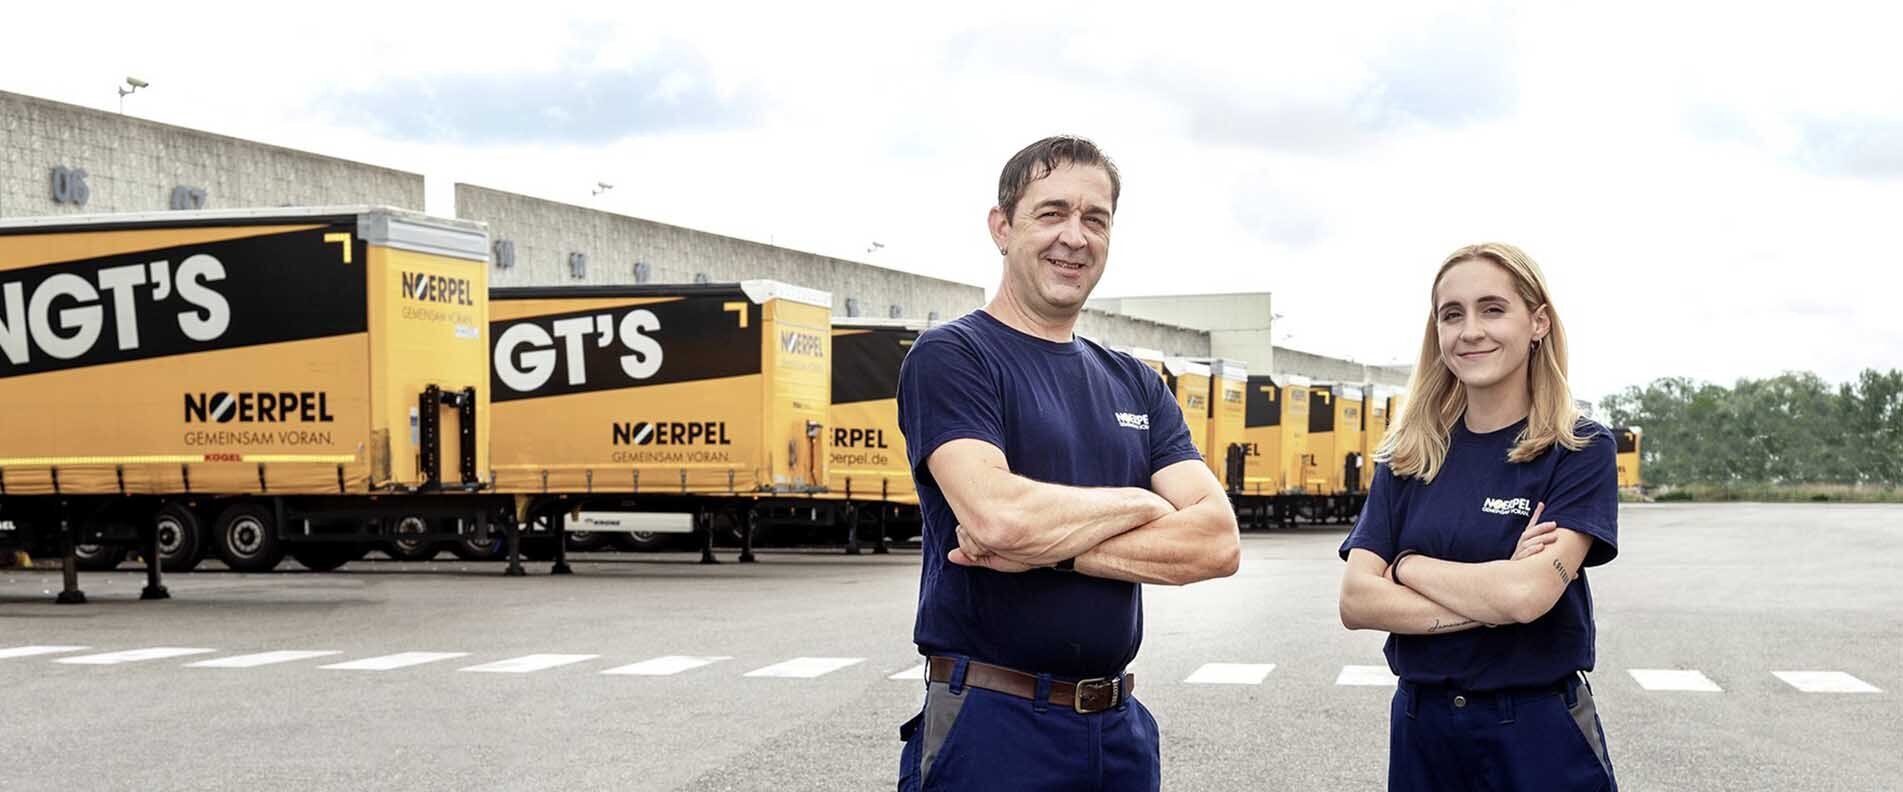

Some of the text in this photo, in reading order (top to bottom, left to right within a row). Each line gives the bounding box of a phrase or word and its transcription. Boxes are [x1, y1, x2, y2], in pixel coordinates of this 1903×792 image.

[51, 165, 90, 207] 06
[402, 271, 473, 306] NOERPEL
[0, 254, 230, 365] NGT'S
[494, 309, 663, 392] GT'S
[185, 392, 334, 423] NOERPEL
[184, 431, 335, 446] GEMEINSAM VORAN.
[612, 421, 731, 446] NOERPEL
[830, 427, 888, 449] RPEL
[611, 451, 683, 463] GEMEINSAM
